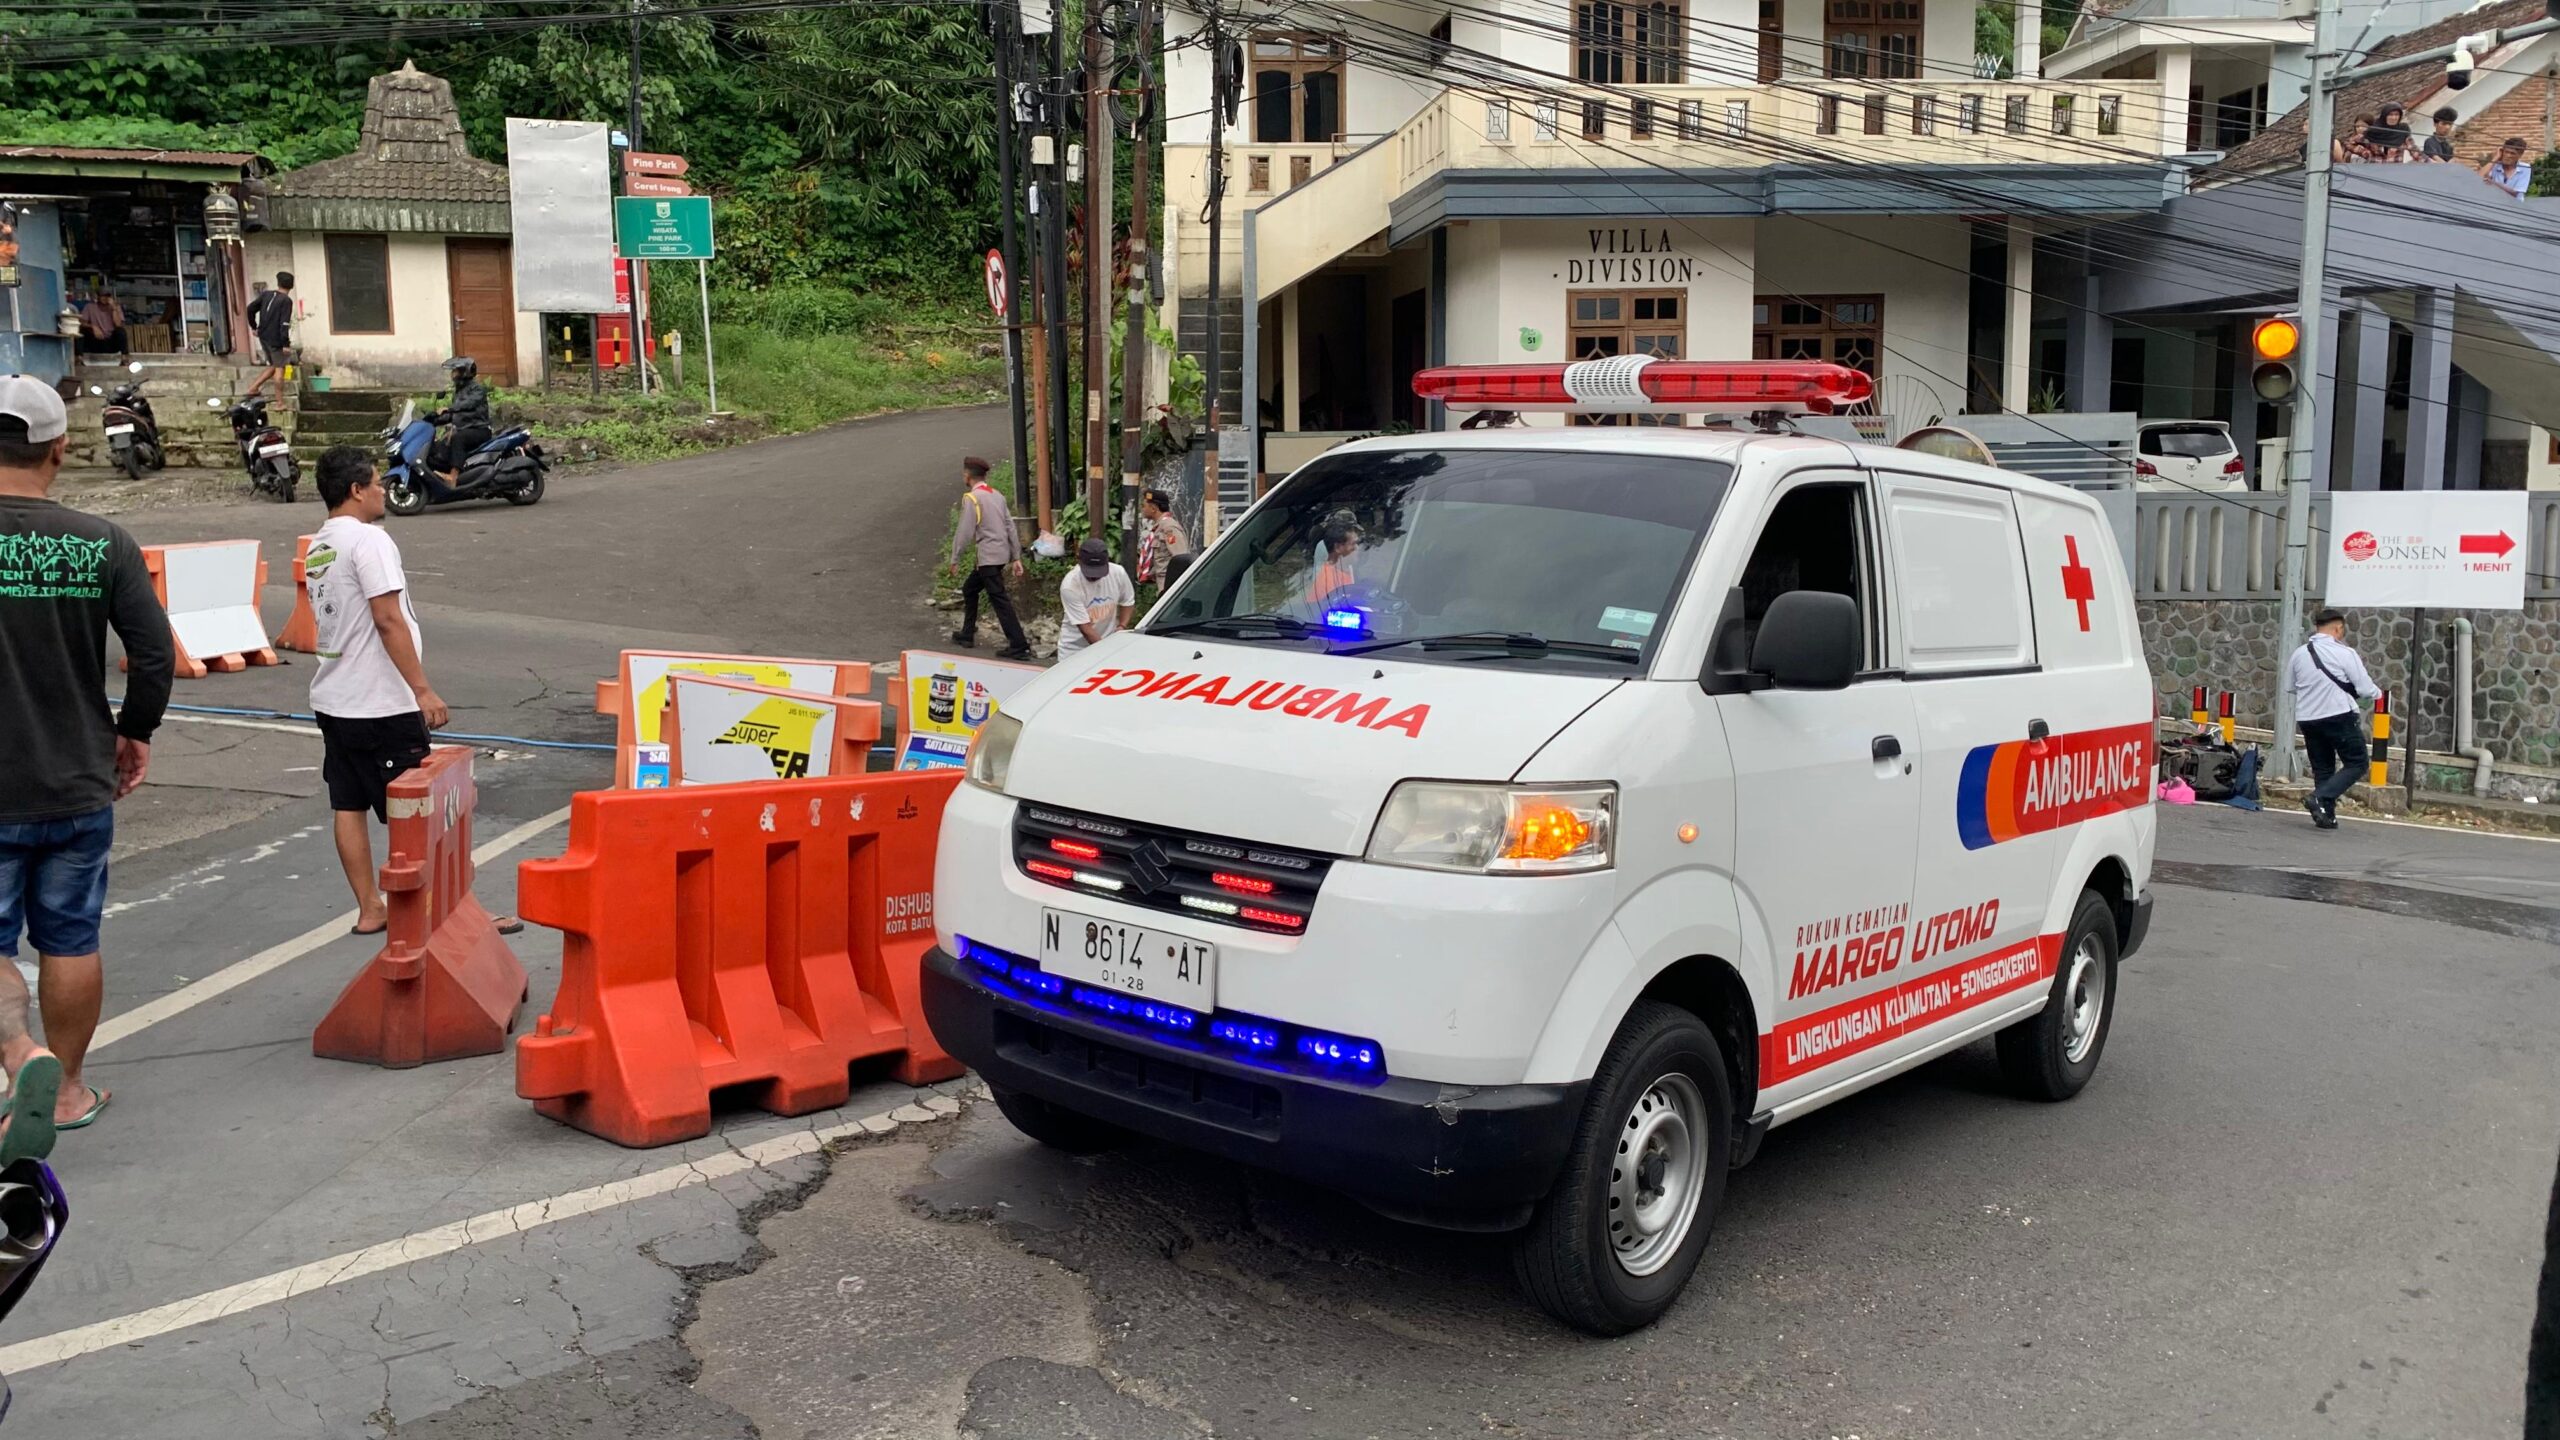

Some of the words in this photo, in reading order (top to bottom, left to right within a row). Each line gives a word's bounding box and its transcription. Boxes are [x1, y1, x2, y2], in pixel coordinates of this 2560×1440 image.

[633, 158, 654, 168] Pine
[656, 159, 678, 170] Park
[1588, 229, 1672, 253] VILLA
[1568, 258, 1693, 284] DIVISION
[2382, 535, 2402, 545] THE
[2377, 545, 2447, 560] ONSEN
[43, 571, 62, 582] OF
[69, 572, 98, 583] LIFE
[2463, 563, 2468, 572] 1
[2473, 563, 2512, 572] MENIT
[932, 681, 955, 693] ABC
[924, 739, 967, 755] SATLANTAS
[2022, 740, 2141, 815] AMBULANCE
[886, 892, 932, 918] DISHUB
[886, 919, 908, 935] KOTA
[911, 916, 932, 931] BATU
[1797, 917, 1841, 948] RUKUN
[1845, 902, 1908, 935] KEMATIAN
[1047, 912, 1060, 952] N
[1085, 921, 1144, 970] 8614
[1177, 942, 1208, 985] AT
[1788, 925, 1905, 1000] MARGO
[1911, 898, 2000, 963] UTOMO
[1787, 1004, 1882, 1065] LINGKUNGAN
[1961, 948, 2037, 998] SONGGOKERTO
